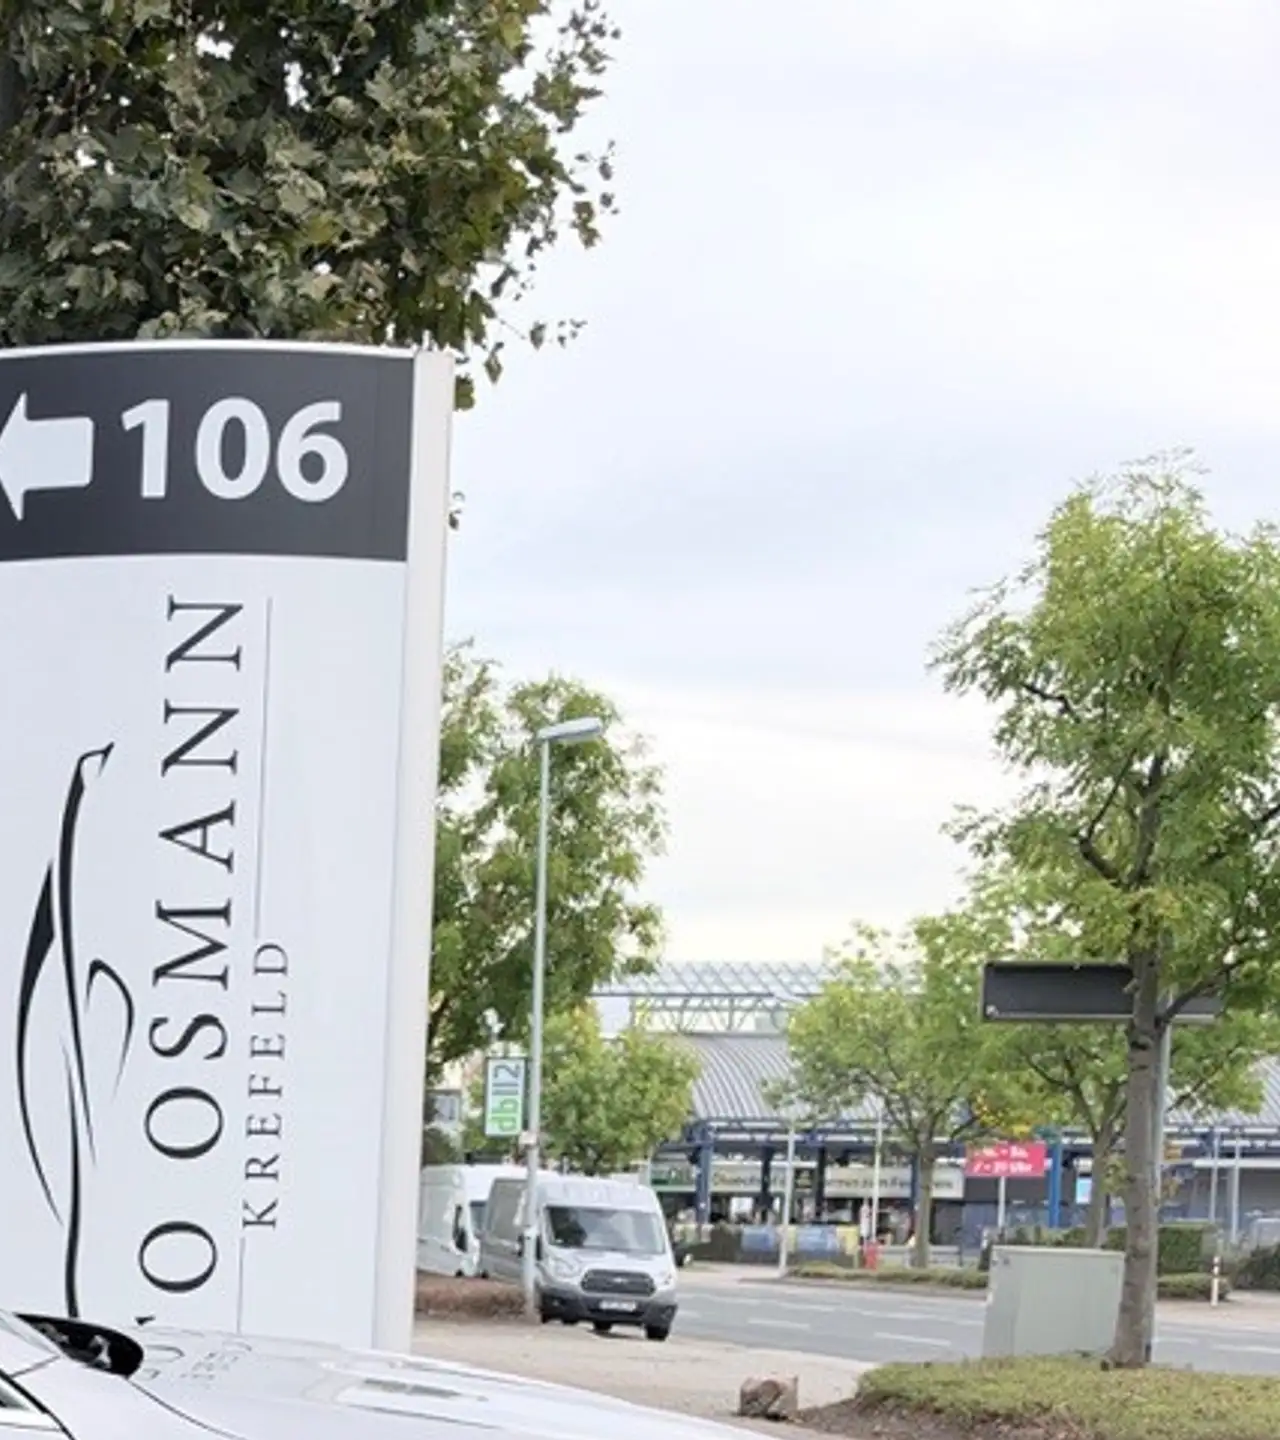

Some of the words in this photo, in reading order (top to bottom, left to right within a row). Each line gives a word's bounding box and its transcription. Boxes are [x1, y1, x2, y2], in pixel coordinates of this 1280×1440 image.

[120, 396, 350, 503] 106
[133, 593, 244, 1326] OOSMANN
[242, 942, 289, 1229] KREFELD
